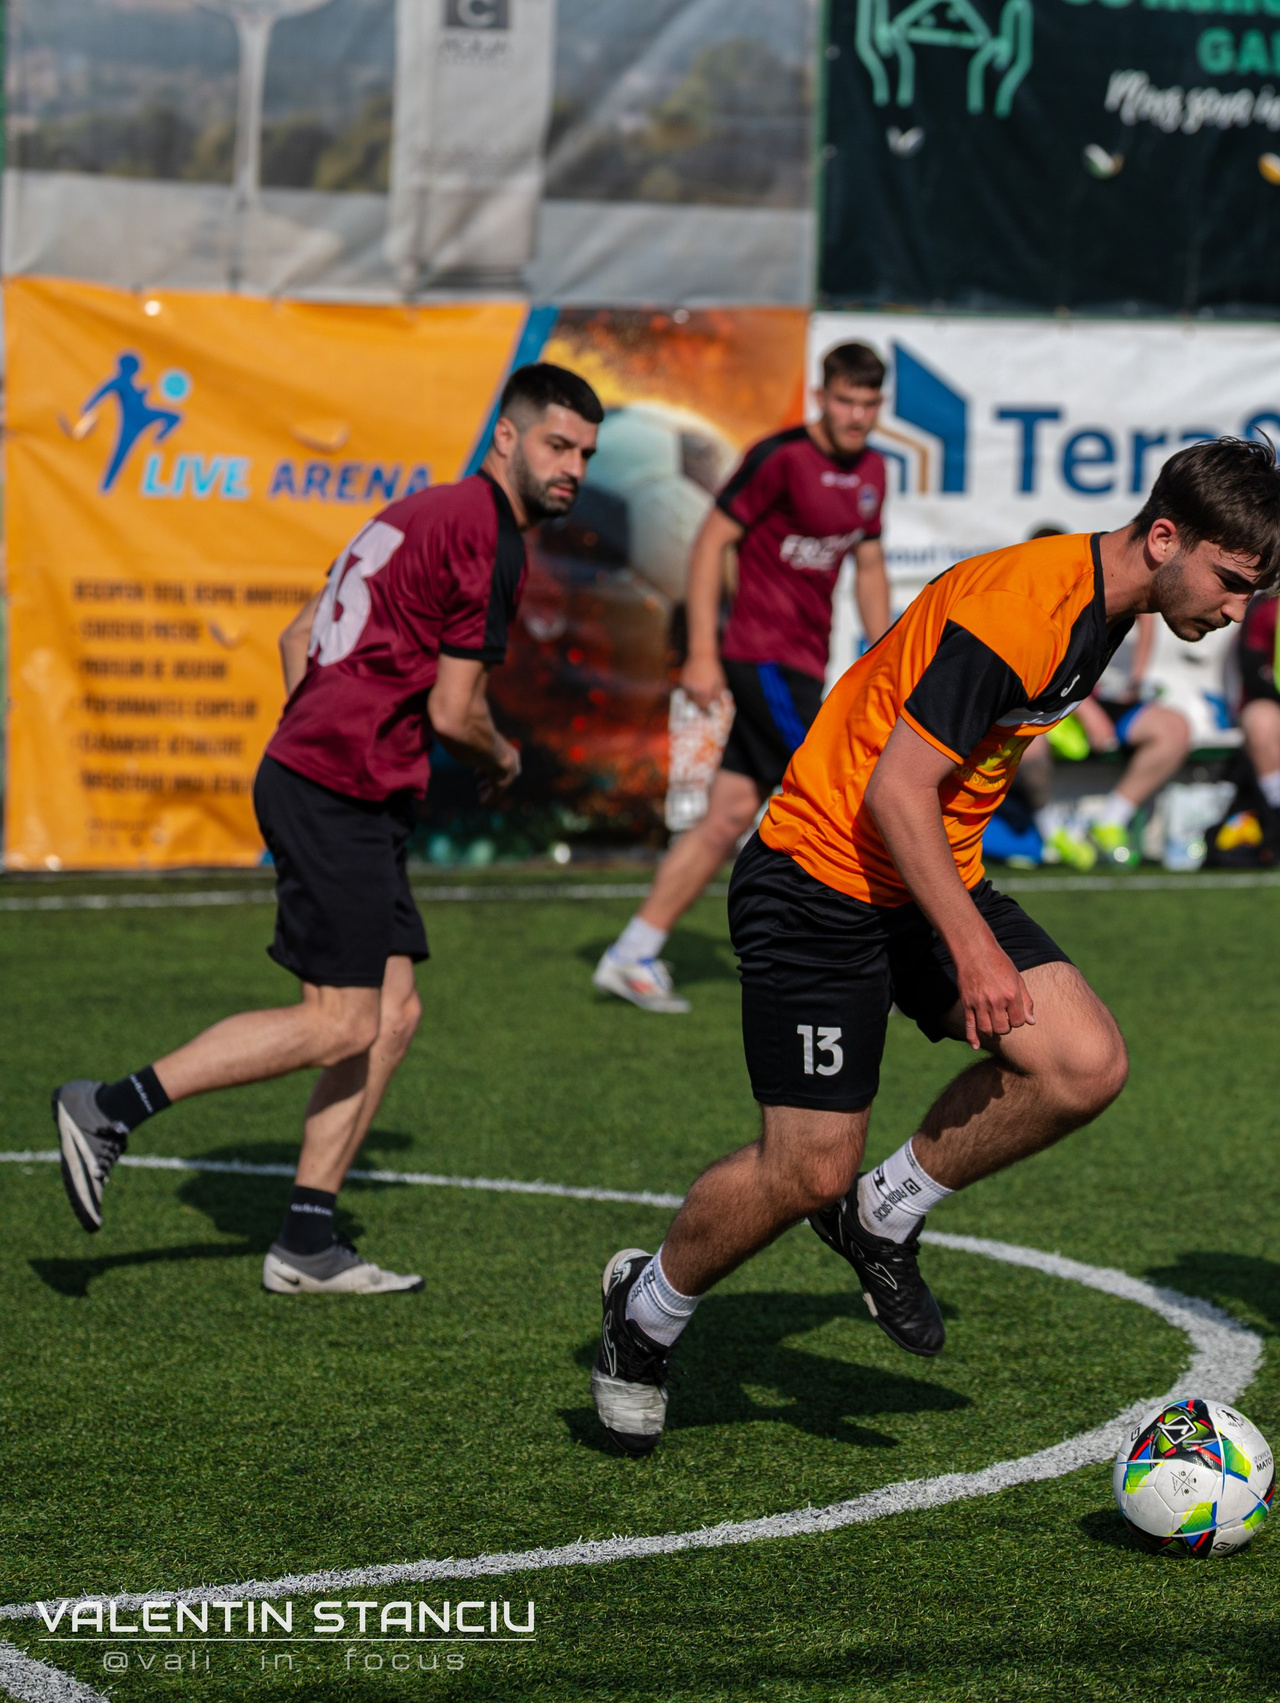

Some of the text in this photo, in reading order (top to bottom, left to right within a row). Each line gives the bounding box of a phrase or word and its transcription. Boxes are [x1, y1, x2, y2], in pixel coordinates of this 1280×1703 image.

[143, 454, 431, 504] LIVE ARENA
[797, 1024, 844, 1077] 13
